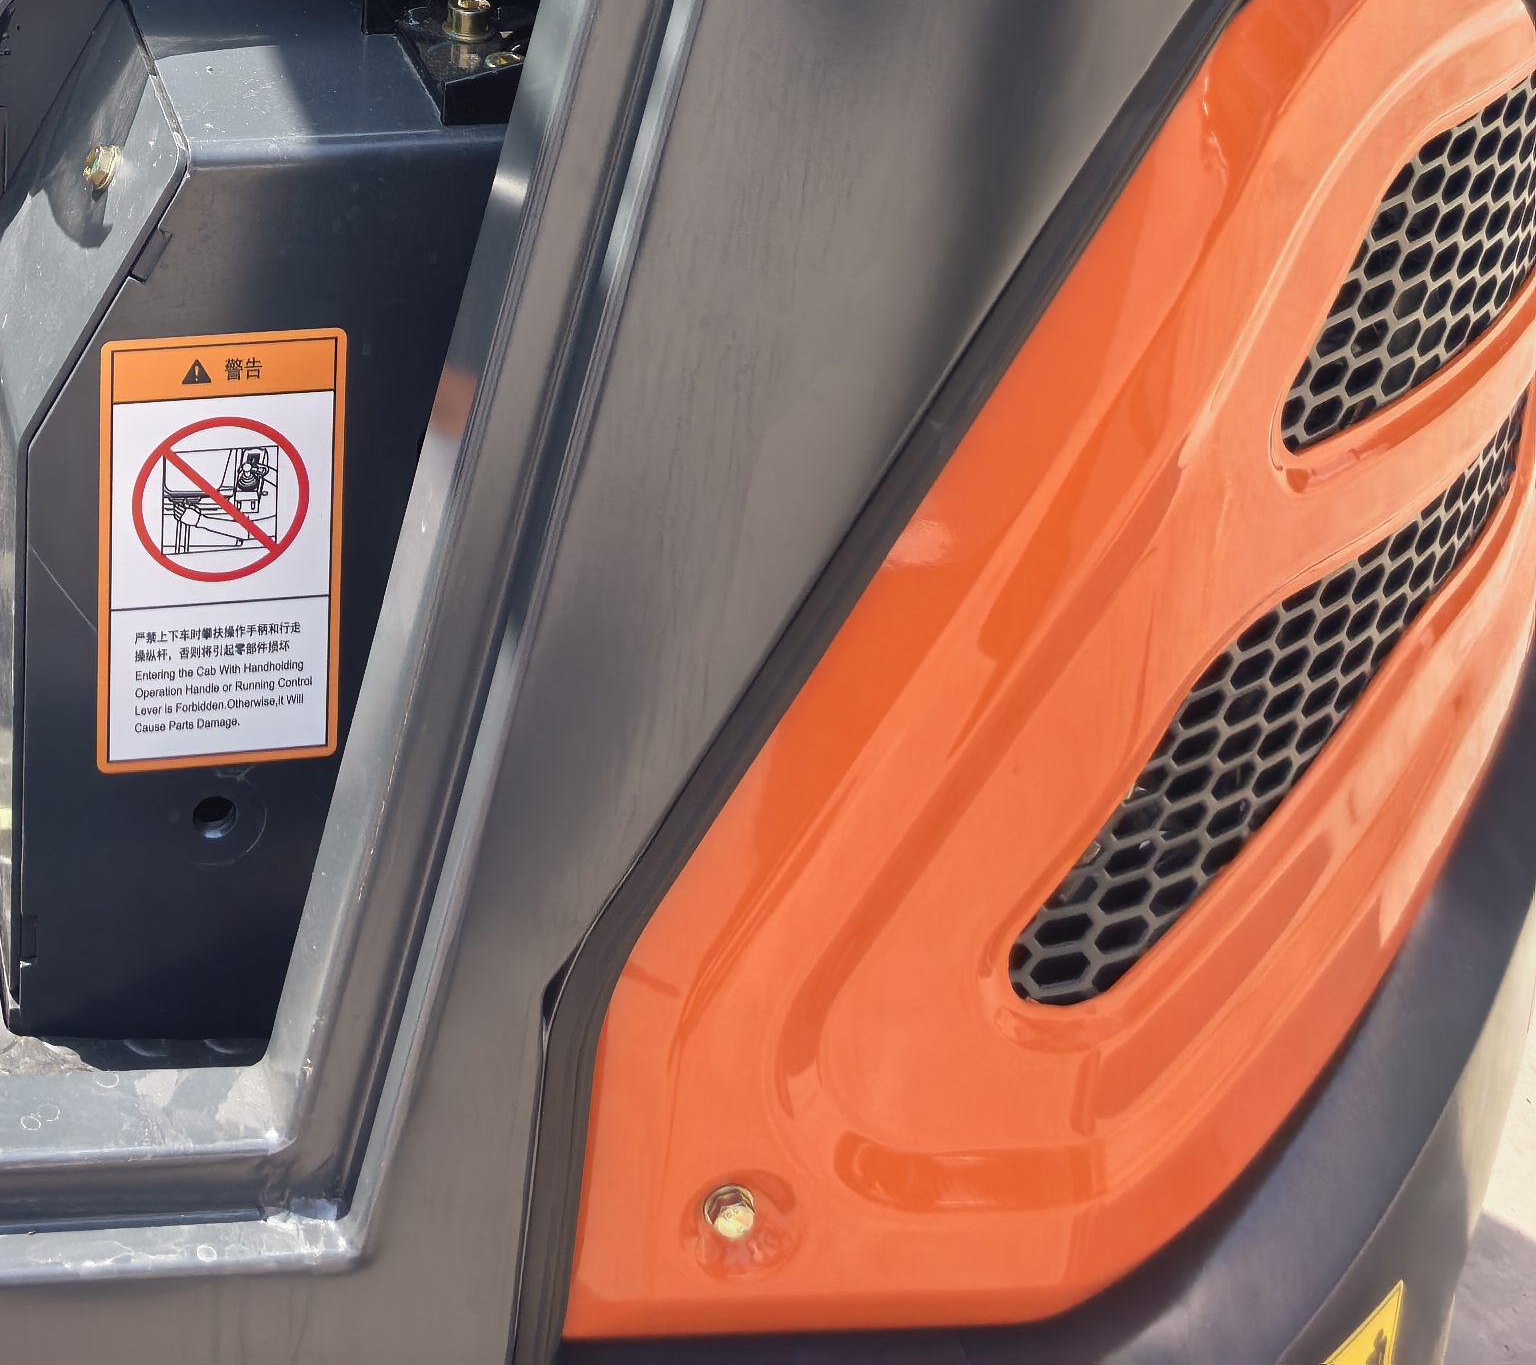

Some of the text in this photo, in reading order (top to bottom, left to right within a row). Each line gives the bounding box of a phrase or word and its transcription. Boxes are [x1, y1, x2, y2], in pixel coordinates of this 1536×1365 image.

[224, 357, 263, 381] 警告
[135, 660, 303, 682] Entering the Cab With Handholding
[135, 676, 313, 701] Operation Handle or Running Control
[135, 704, 162, 716] Lever
[287, 693, 303, 704] Will
[135, 717, 240, 733] Cause Parts Damage.
